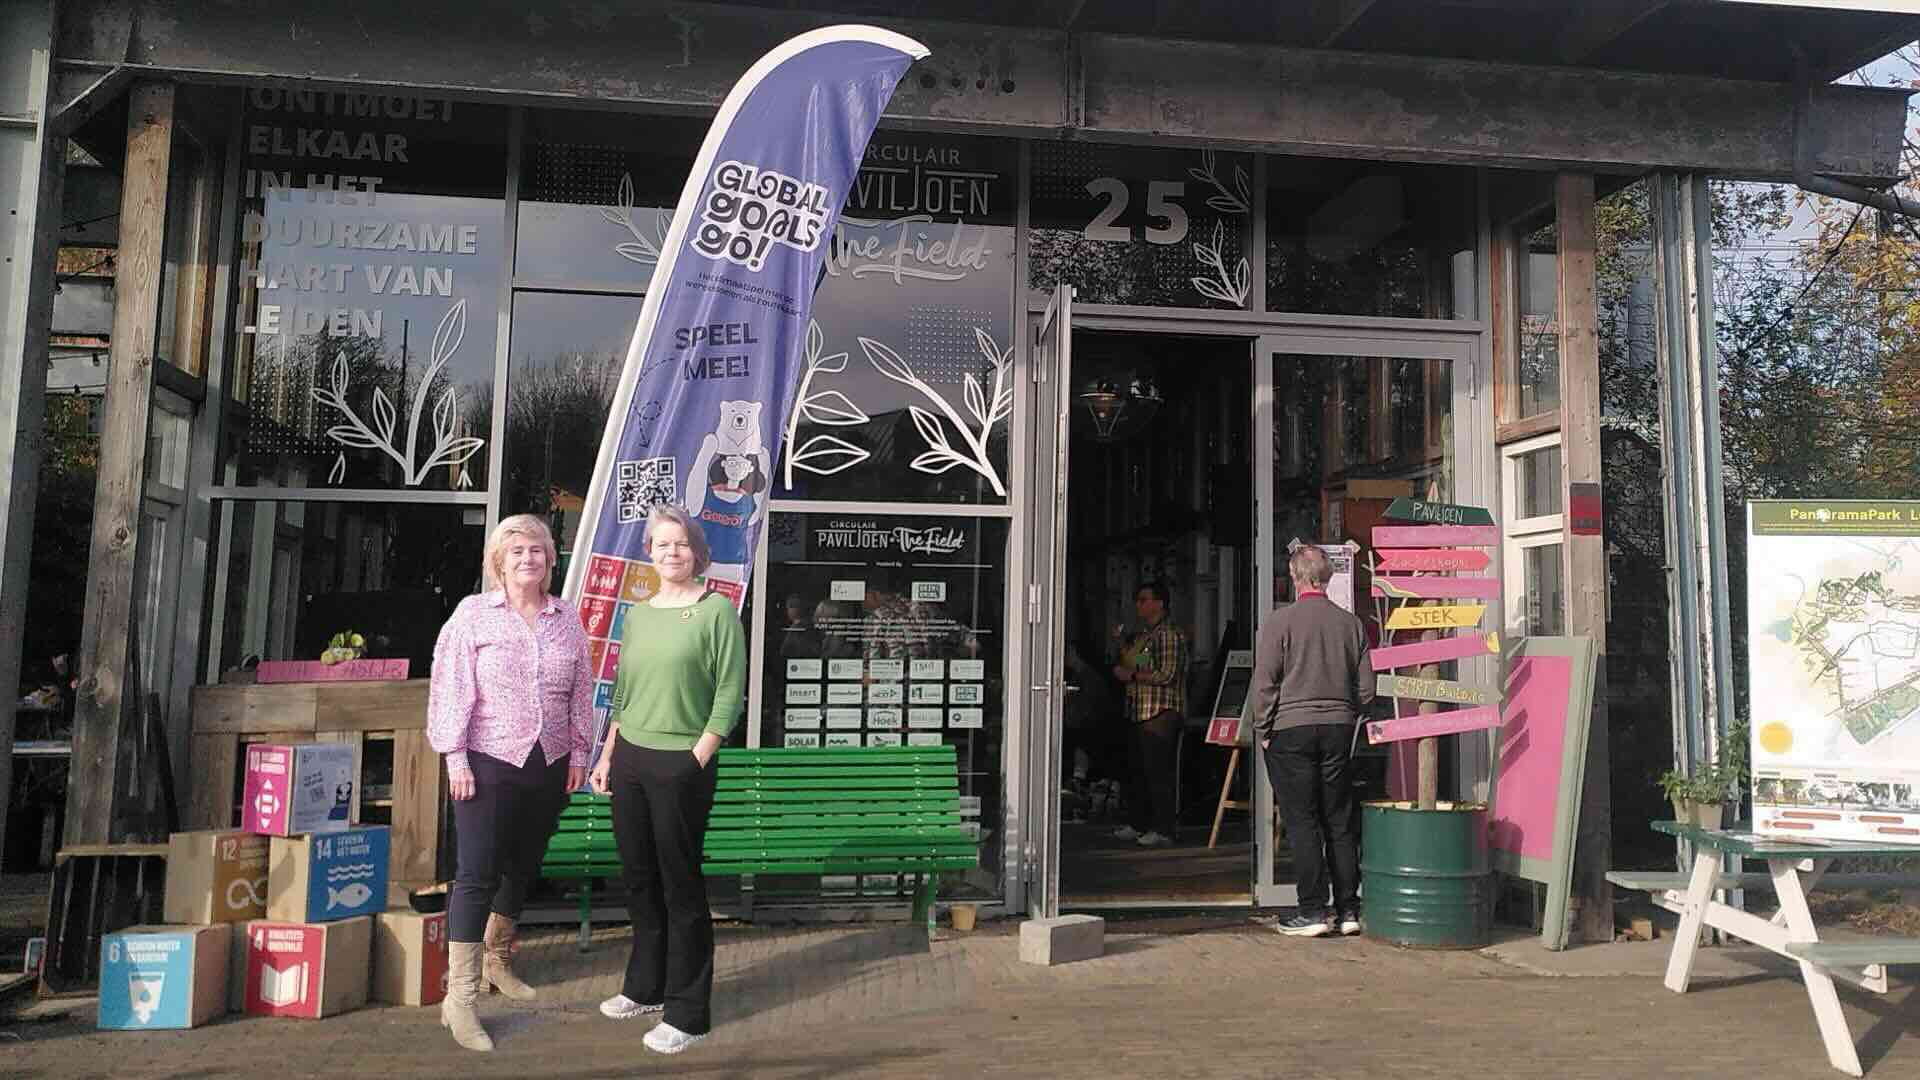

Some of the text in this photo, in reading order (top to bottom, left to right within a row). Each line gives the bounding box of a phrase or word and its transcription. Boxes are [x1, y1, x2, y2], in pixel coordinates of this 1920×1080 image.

[252, 87, 451, 121] ONTMOET
[252, 125, 408, 162] ELKAAR
[866, 145, 961, 164] RCULAIR
[246, 168, 383, 206] IN HET
[717, 165, 824, 216] GLOBAL
[847, 165, 989, 215] VILJOEN
[1084, 177, 1189, 244] 25
[242, 212, 477, 254] DUURZAME
[886, 215, 992, 285] Field
[240, 261, 453, 297] HART VAN
[236, 304, 383, 337] LEIDEN
[675, 322, 758, 350] SPEEL
[684, 356, 750, 380] MEE!
[830, 520, 877, 529] CIRCULAIR
[818, 527, 966, 555] PAVILJOEN The Field
[1409, 608, 1457, 625] STEK
[223, 839, 236, 861] 12
[316, 838, 331, 860] 14
[429, 921, 439, 943] 9
[109, 942, 120, 963] 6
